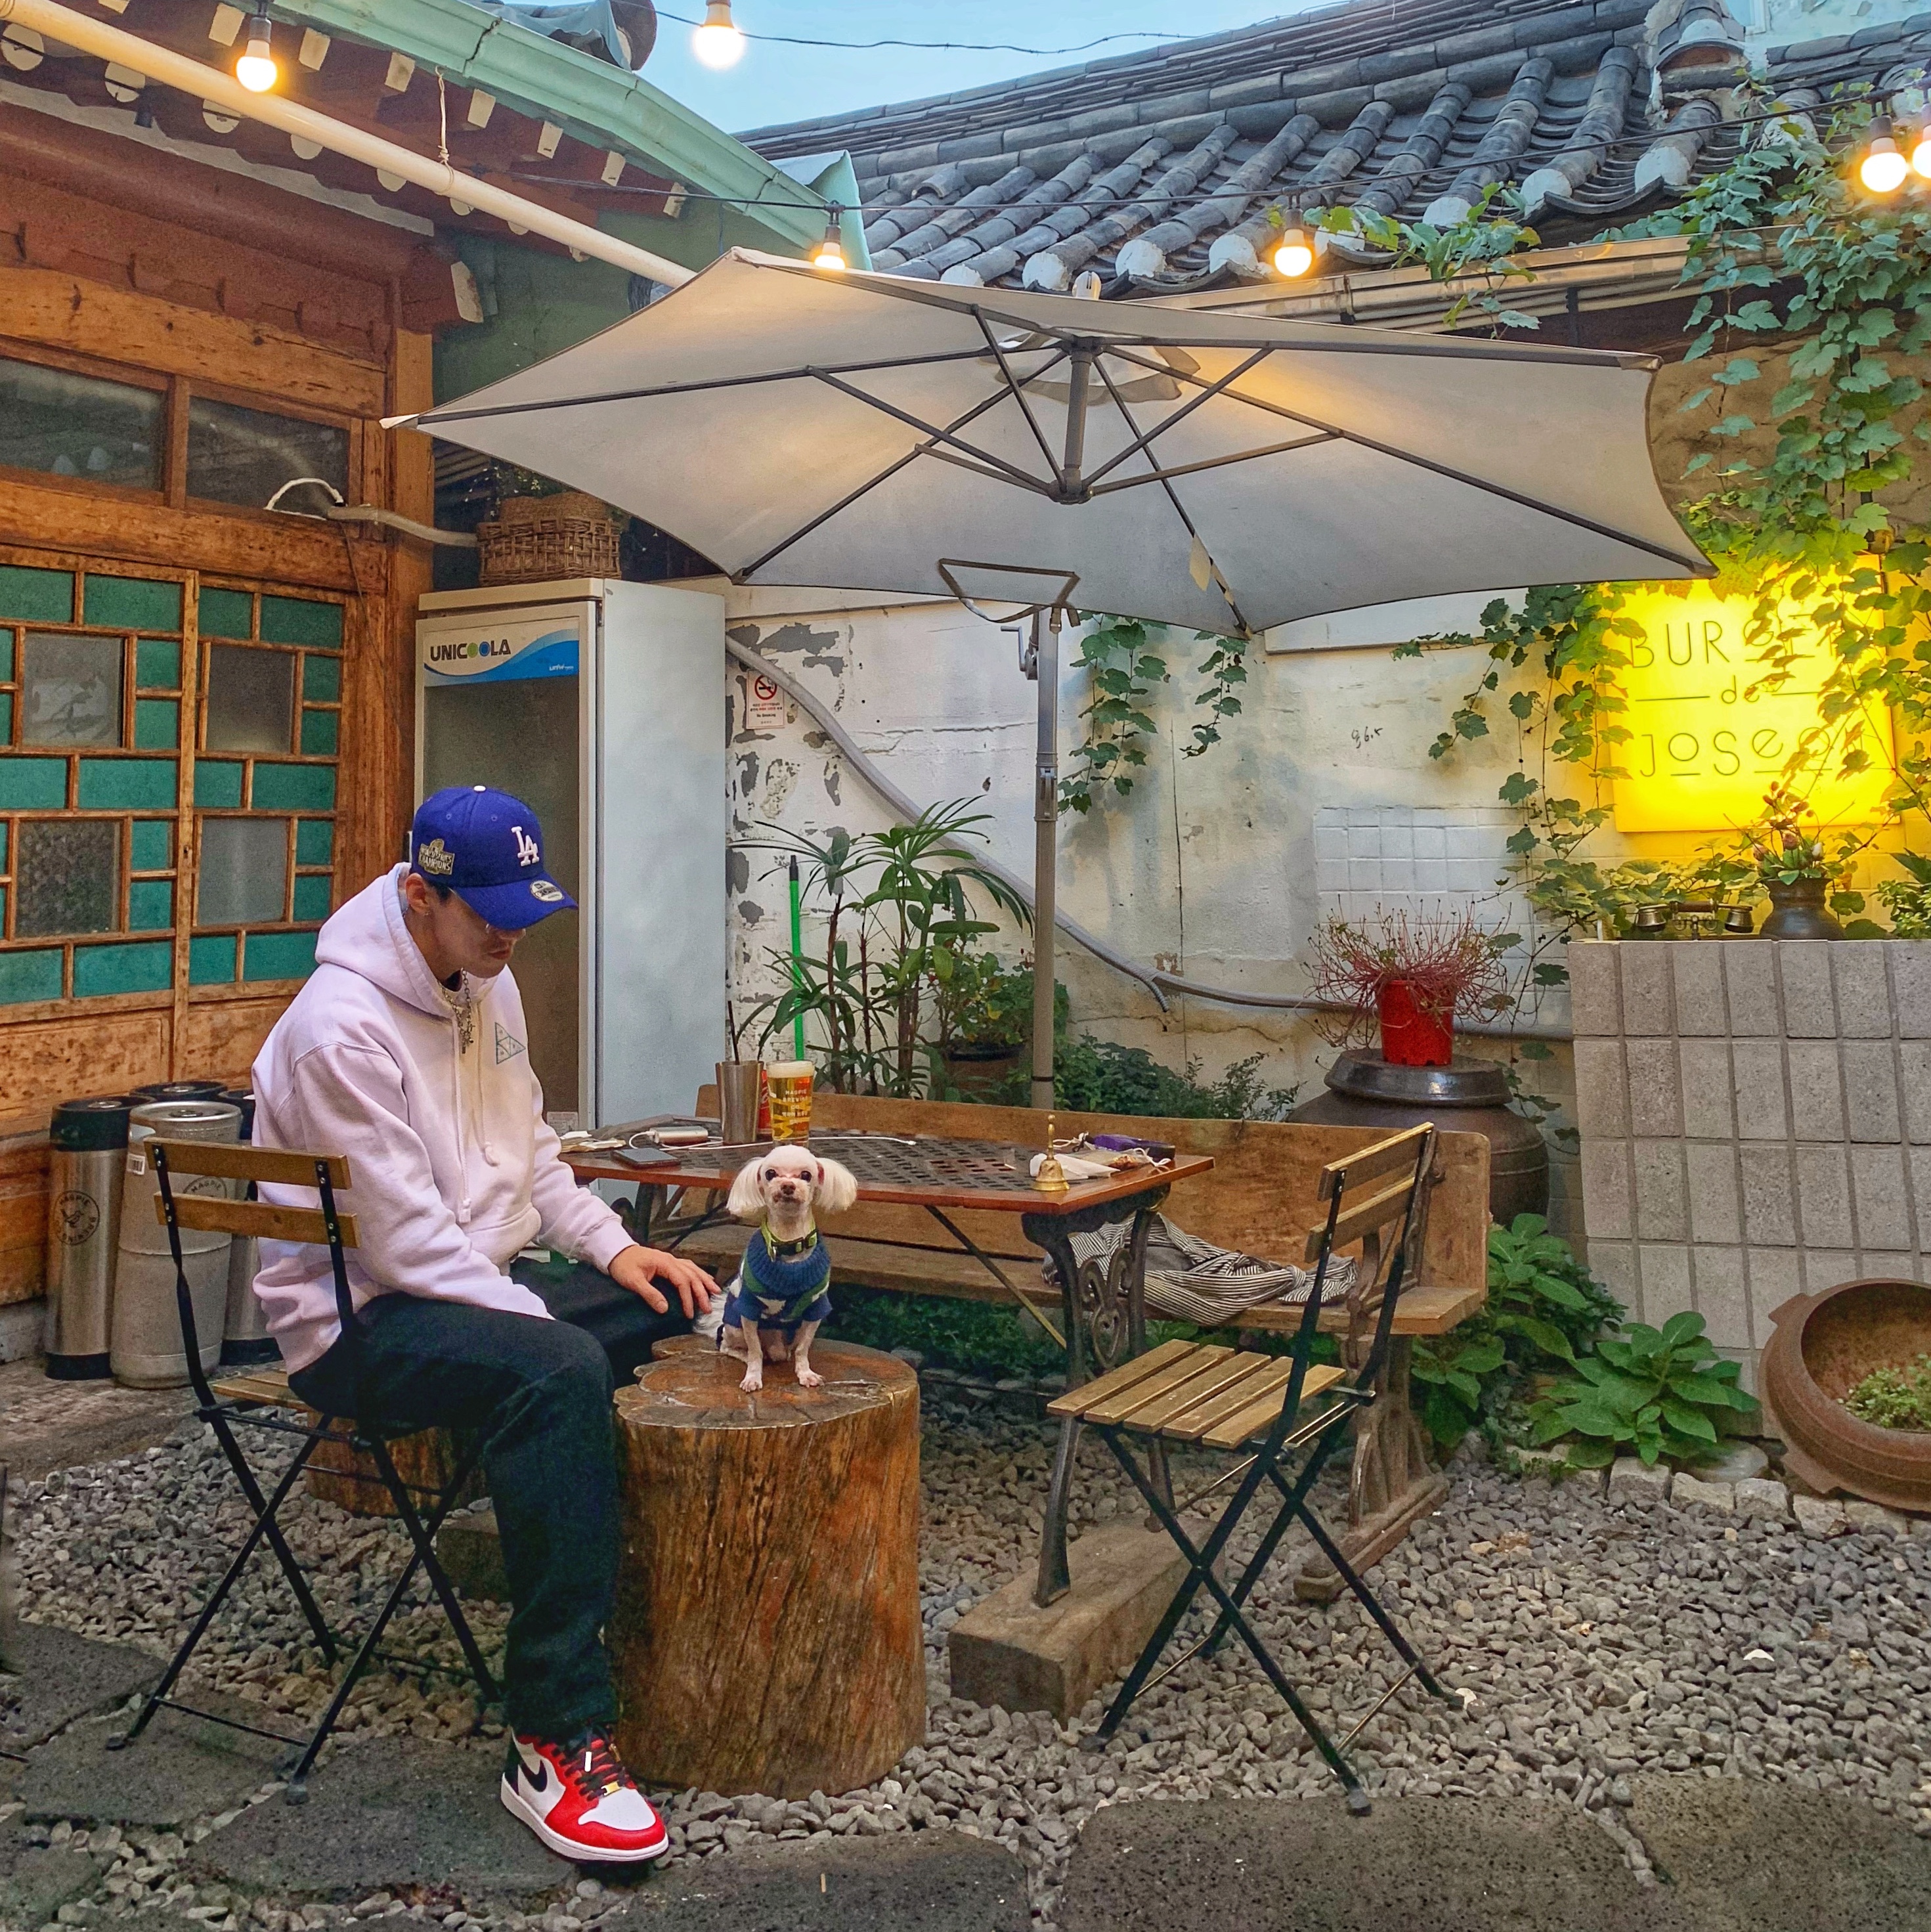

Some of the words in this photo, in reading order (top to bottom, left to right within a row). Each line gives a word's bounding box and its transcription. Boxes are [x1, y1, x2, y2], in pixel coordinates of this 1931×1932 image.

[430, 639, 511, 662] UNICOOLA
[511, 825, 540, 867] LA
[190, 1179, 222, 1193] MAGPIE
